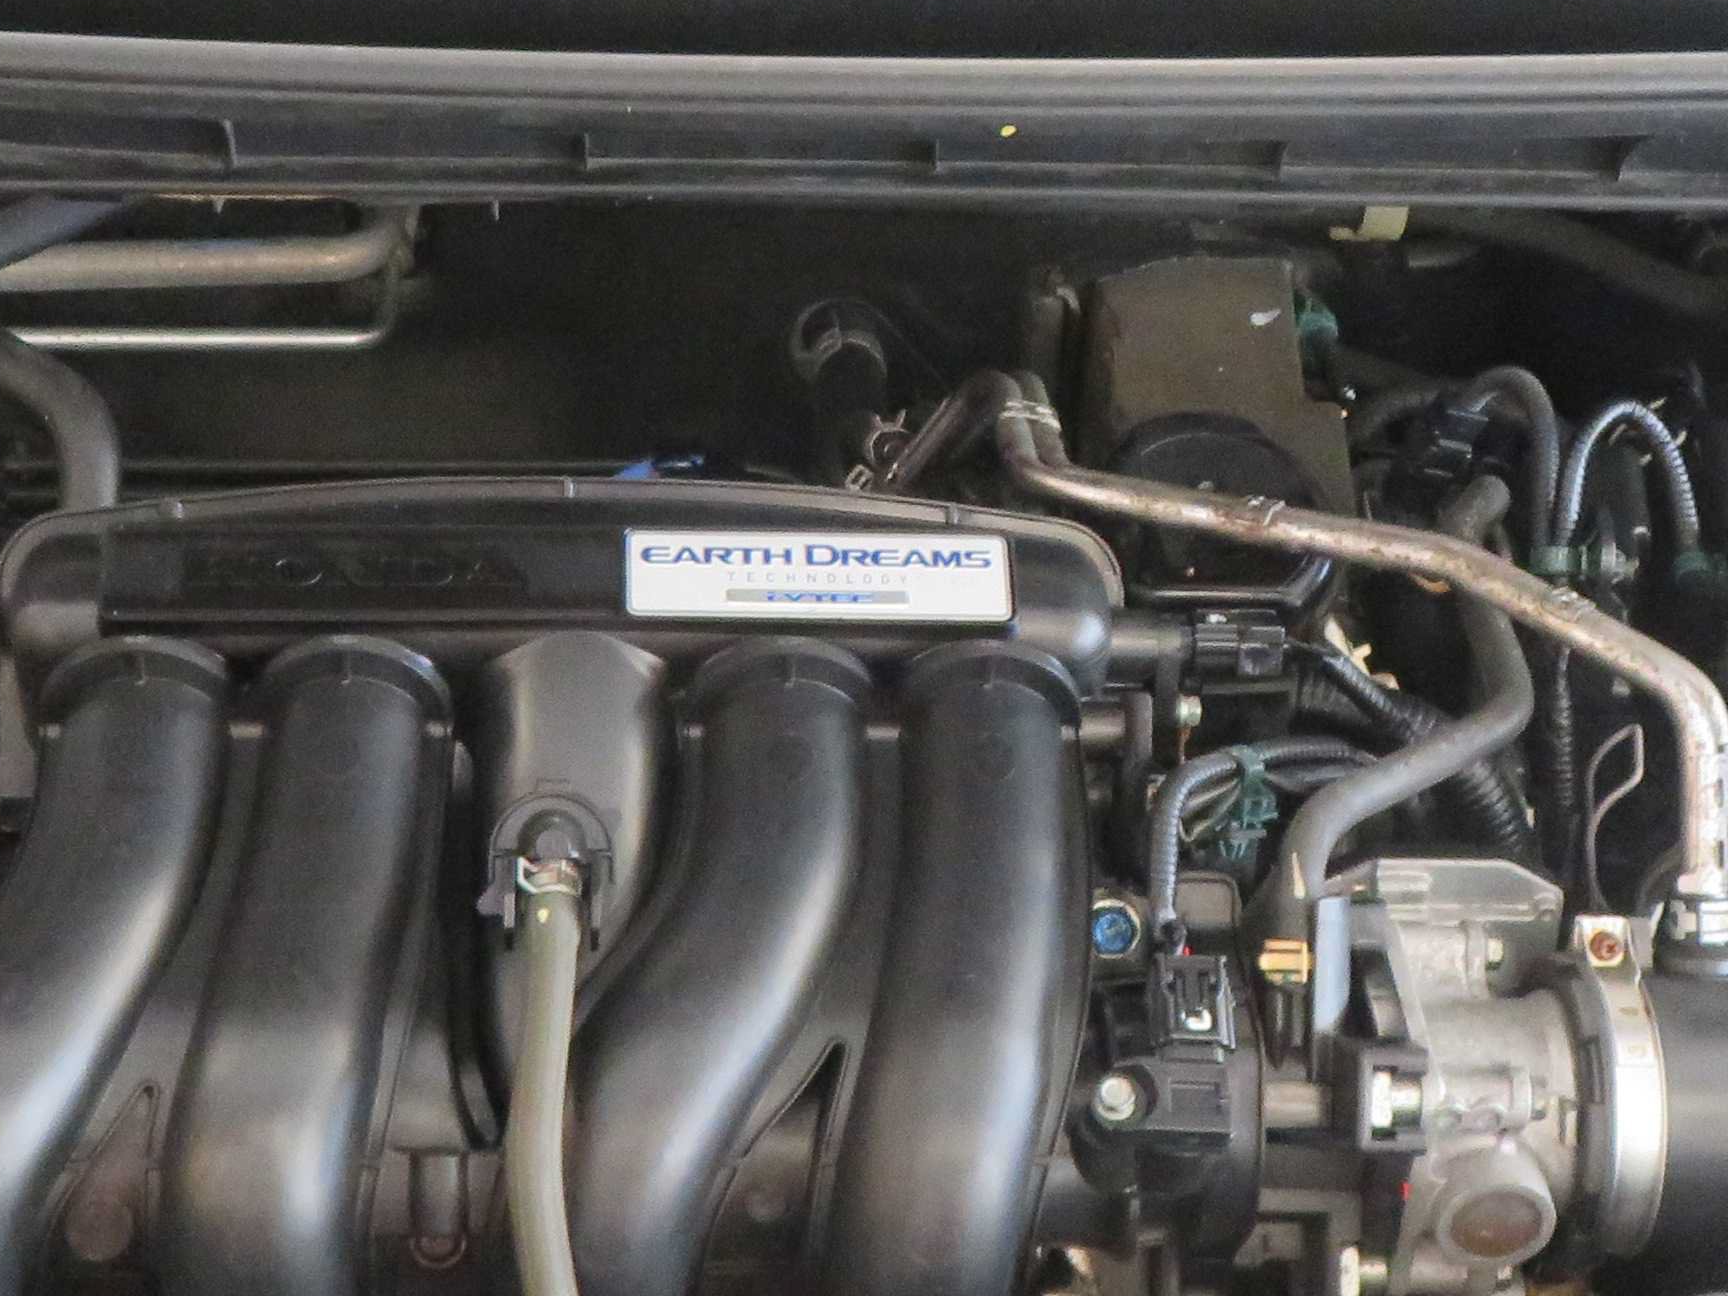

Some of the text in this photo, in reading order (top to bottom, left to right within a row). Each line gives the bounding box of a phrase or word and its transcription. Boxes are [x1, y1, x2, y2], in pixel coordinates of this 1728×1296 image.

[640, 544, 993, 569] EARTH DREAMS
[727, 571, 910, 585] TECHNOLOGY
